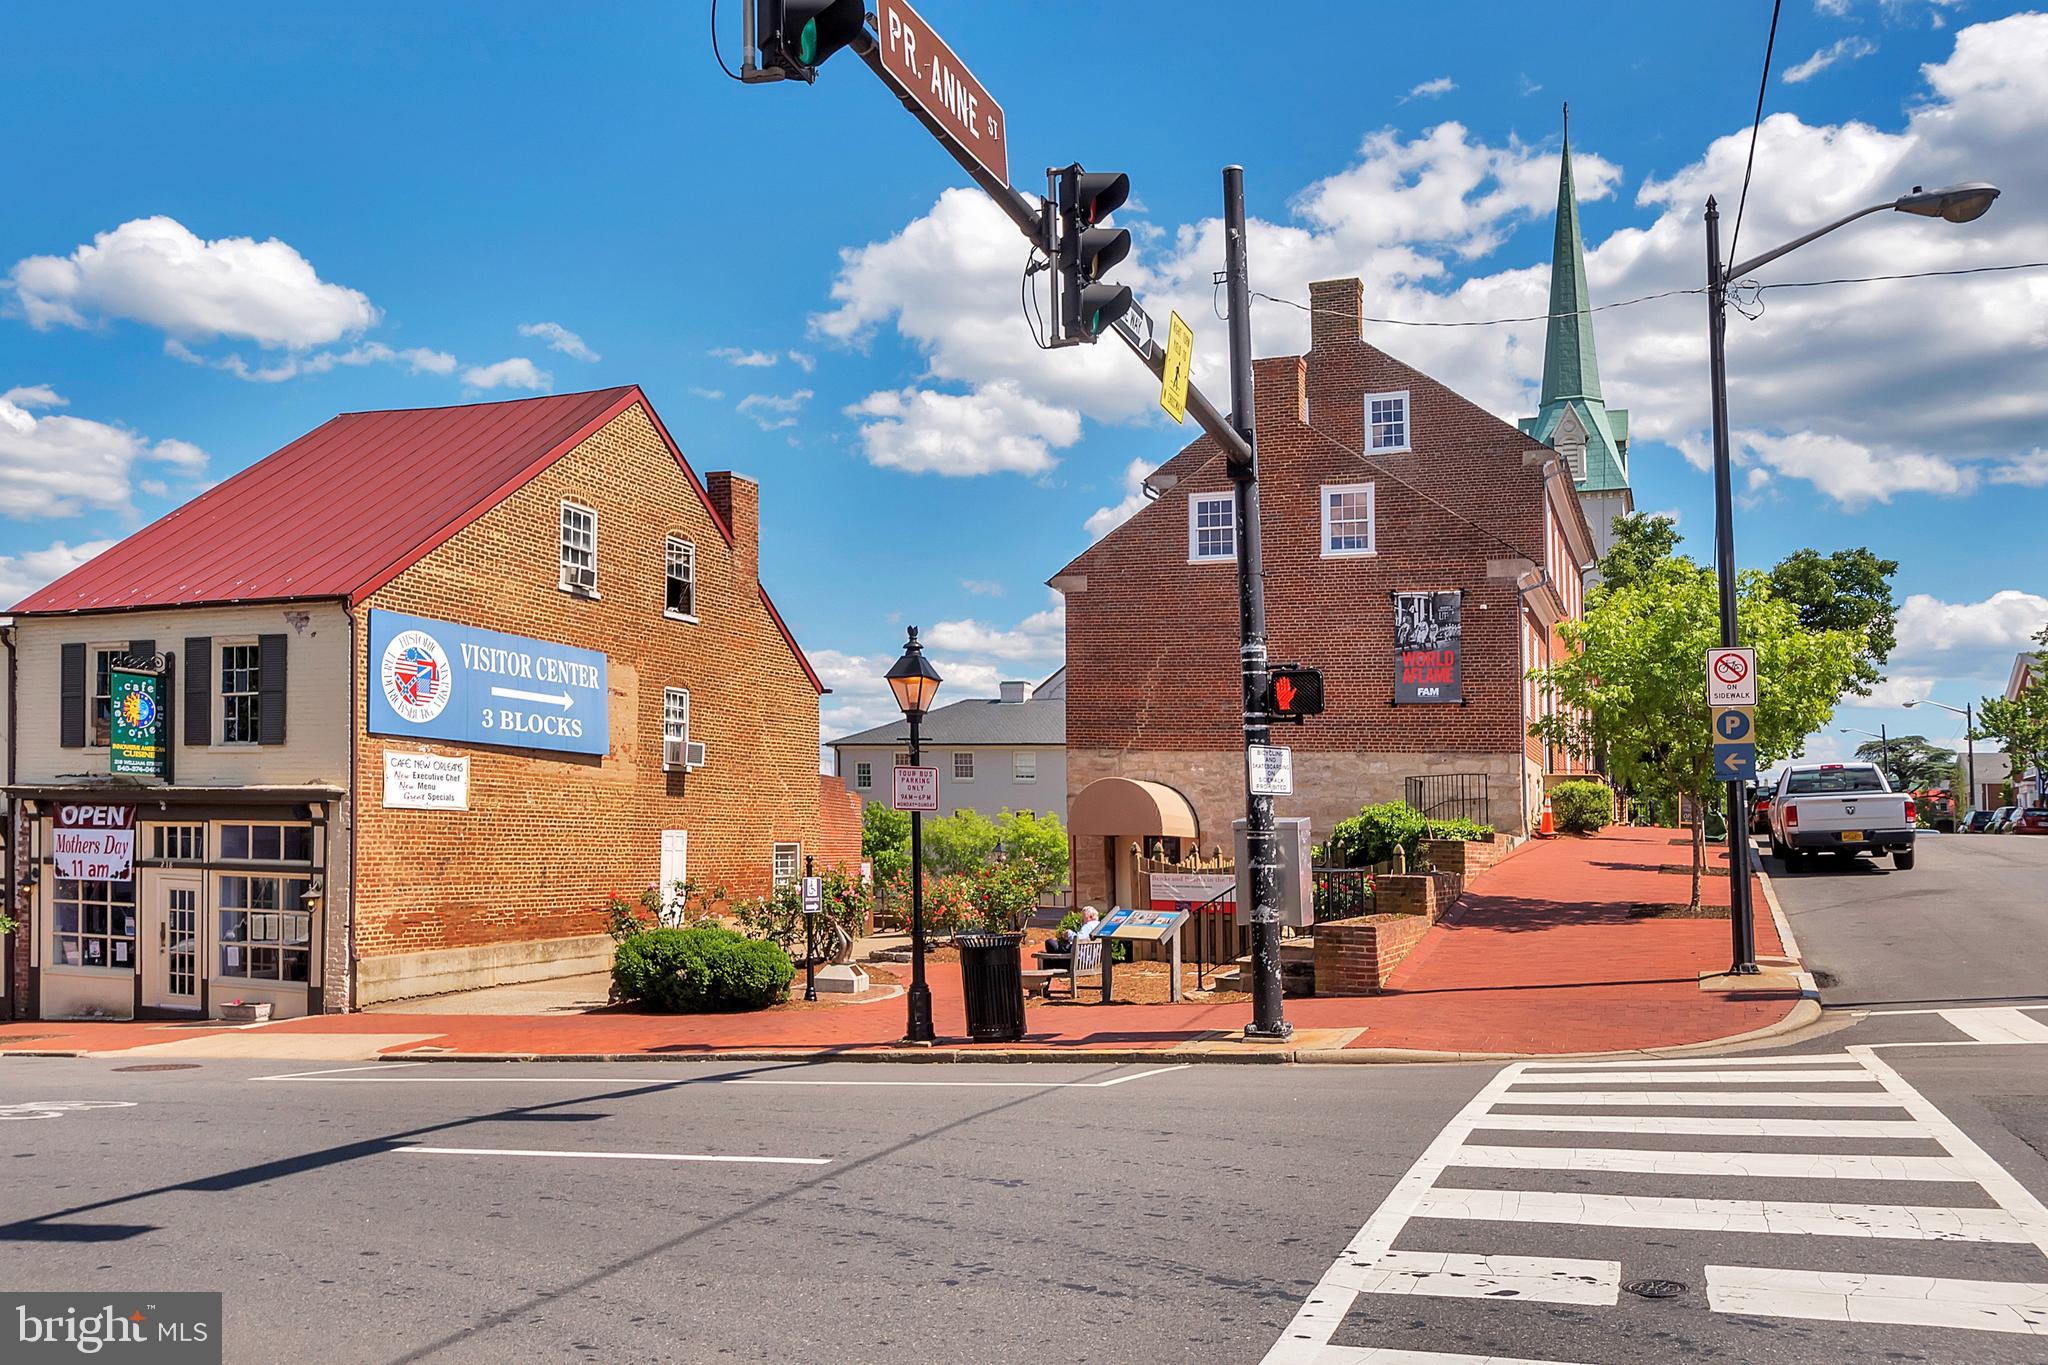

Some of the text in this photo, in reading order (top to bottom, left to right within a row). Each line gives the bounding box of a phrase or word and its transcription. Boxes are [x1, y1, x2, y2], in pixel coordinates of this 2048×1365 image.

[888, 6, 922, 79] PR.
[931, 55, 980, 139] ANNE
[399, 632, 437, 653] HISTORIC
[460, 642, 600, 690] VISITOR CENTER
[1402, 650, 1455, 667] WORLD
[1402, 667, 1455, 685] AFLAME
[124, 681, 154, 693] cafe
[1417, 687, 1439, 696] FAM
[113, 700, 126, 728] new
[481, 708, 583, 738] 3 BLOCKS
[1725, 716, 1740, 734] P
[414, 760, 431, 769] NEW
[433, 761, 464, 772] ORLEANS
[394, 770, 460, 782] New Executive Chef
[399, 781, 436, 790] New Menu
[403, 791, 455, 802] Great Specials
[61, 805, 125, 826] OPEN
[55, 833, 129, 860] Mothers Day
[72, 859, 109, 878] 11 am
